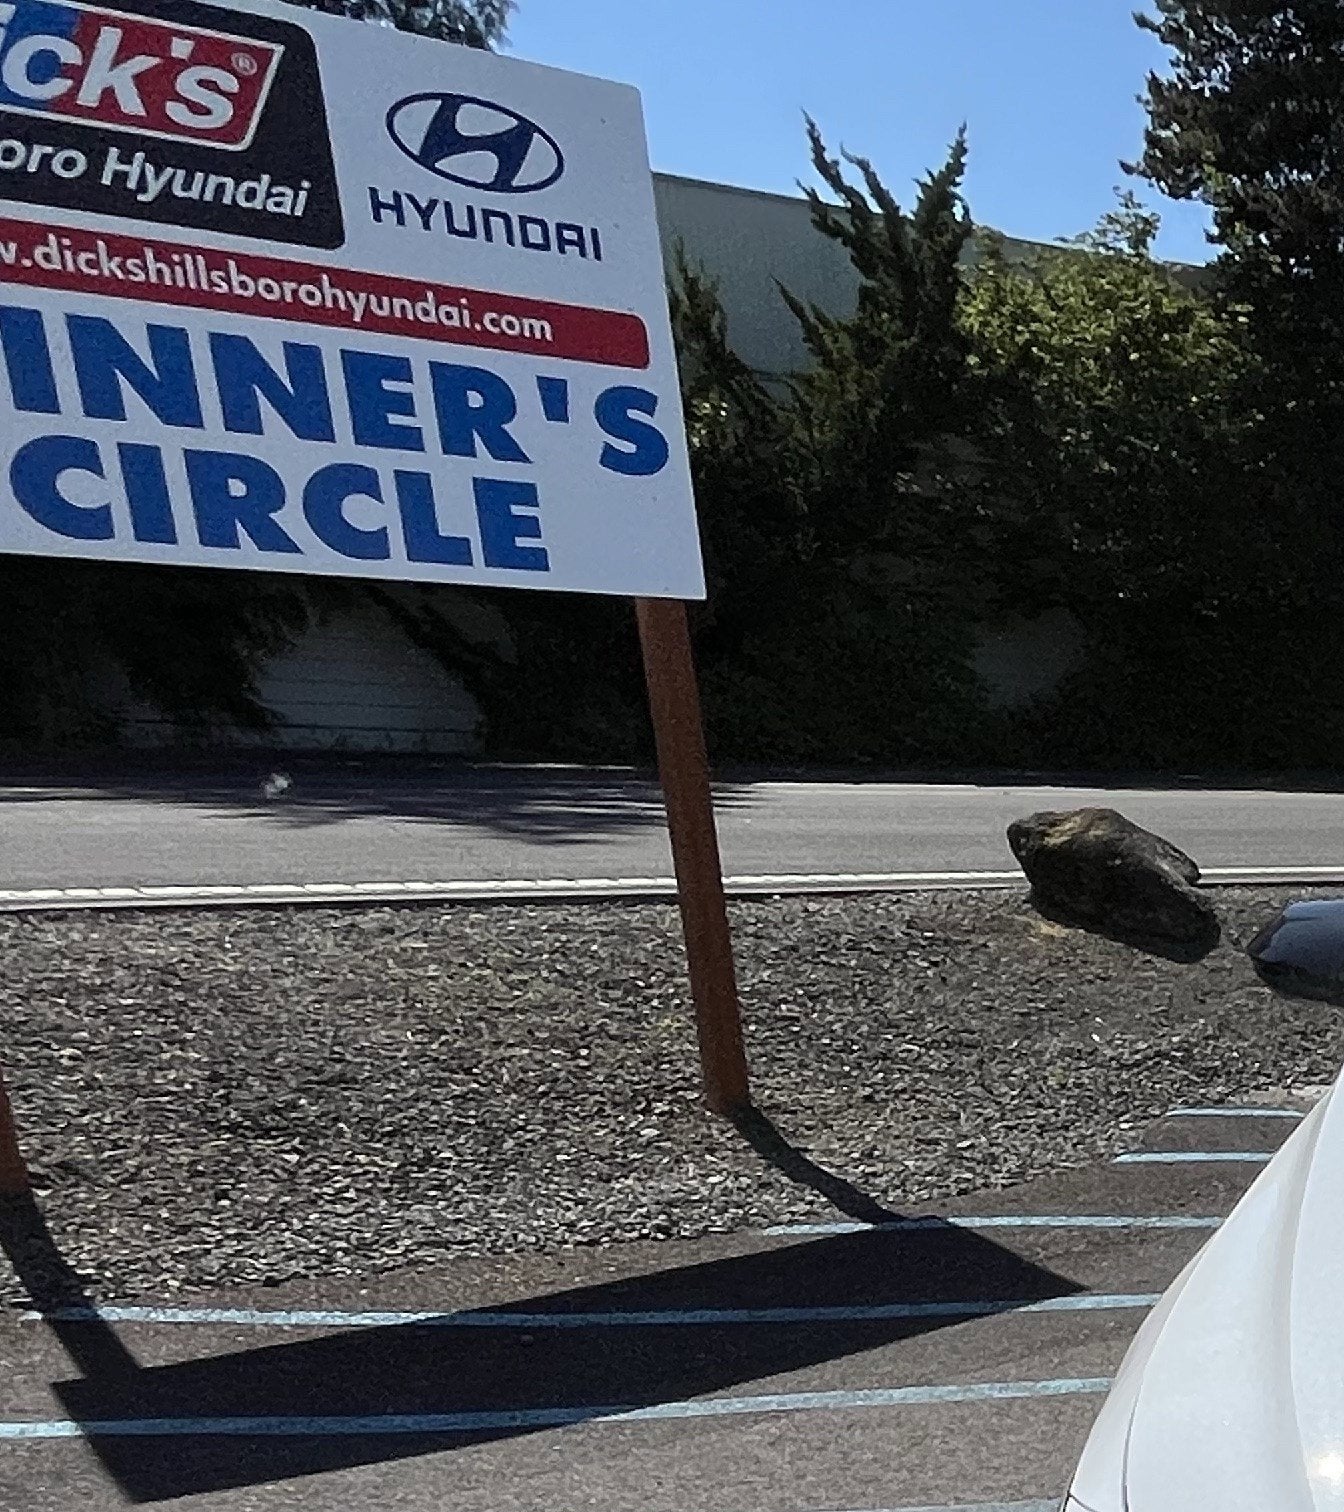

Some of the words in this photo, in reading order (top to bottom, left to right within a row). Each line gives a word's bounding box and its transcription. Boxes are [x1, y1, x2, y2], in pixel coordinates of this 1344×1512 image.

[0, 4, 240, 129] ck's
[101, 147, 312, 217] Hyundai
[366, 186, 602, 262] HYUNDAI
[0, 304, 669, 475] INNER'S
[9, 434, 550, 572] CIRCLE
